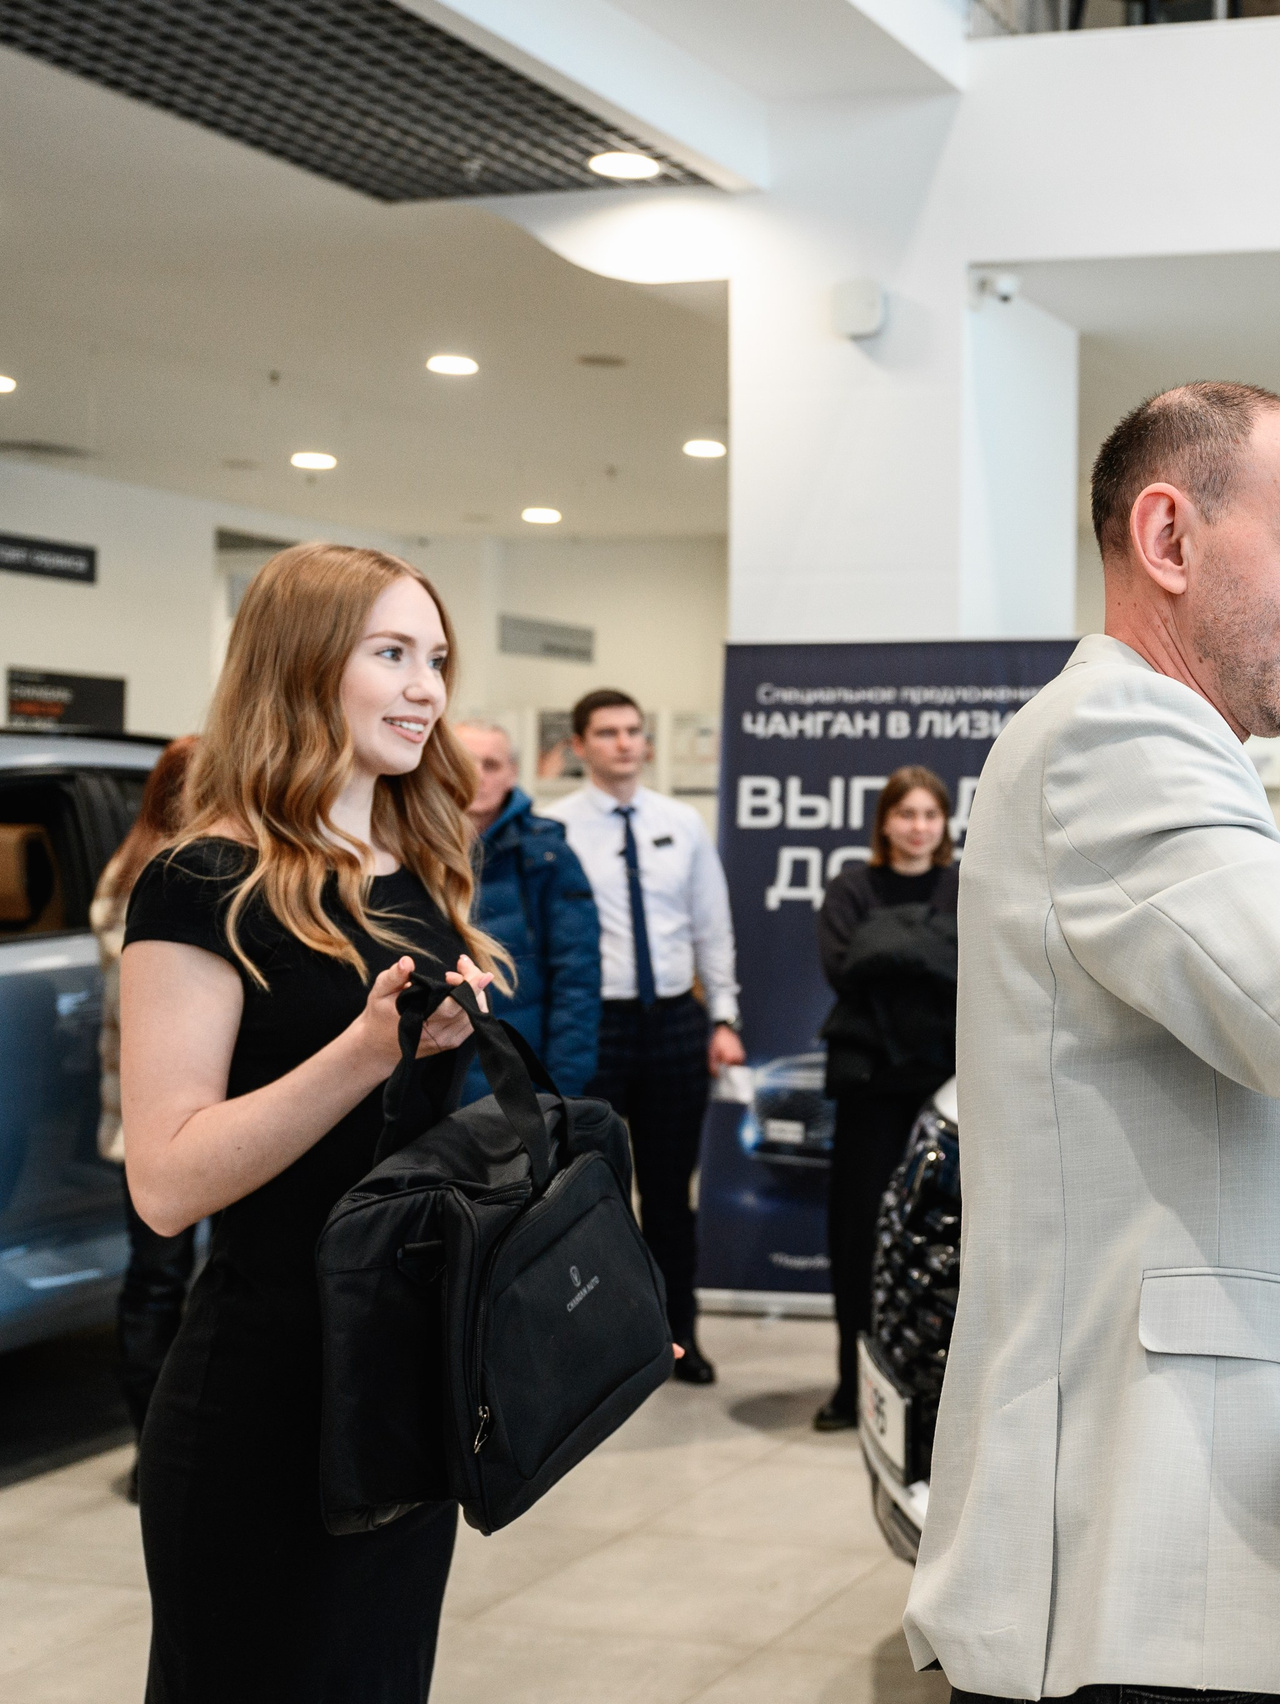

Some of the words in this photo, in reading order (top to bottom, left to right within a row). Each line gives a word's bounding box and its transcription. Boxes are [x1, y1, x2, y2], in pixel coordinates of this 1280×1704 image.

[756, 682, 896, 706] Специальное
[741, 710, 880, 740] ЧАНГАН
[886, 711, 910, 739] В
